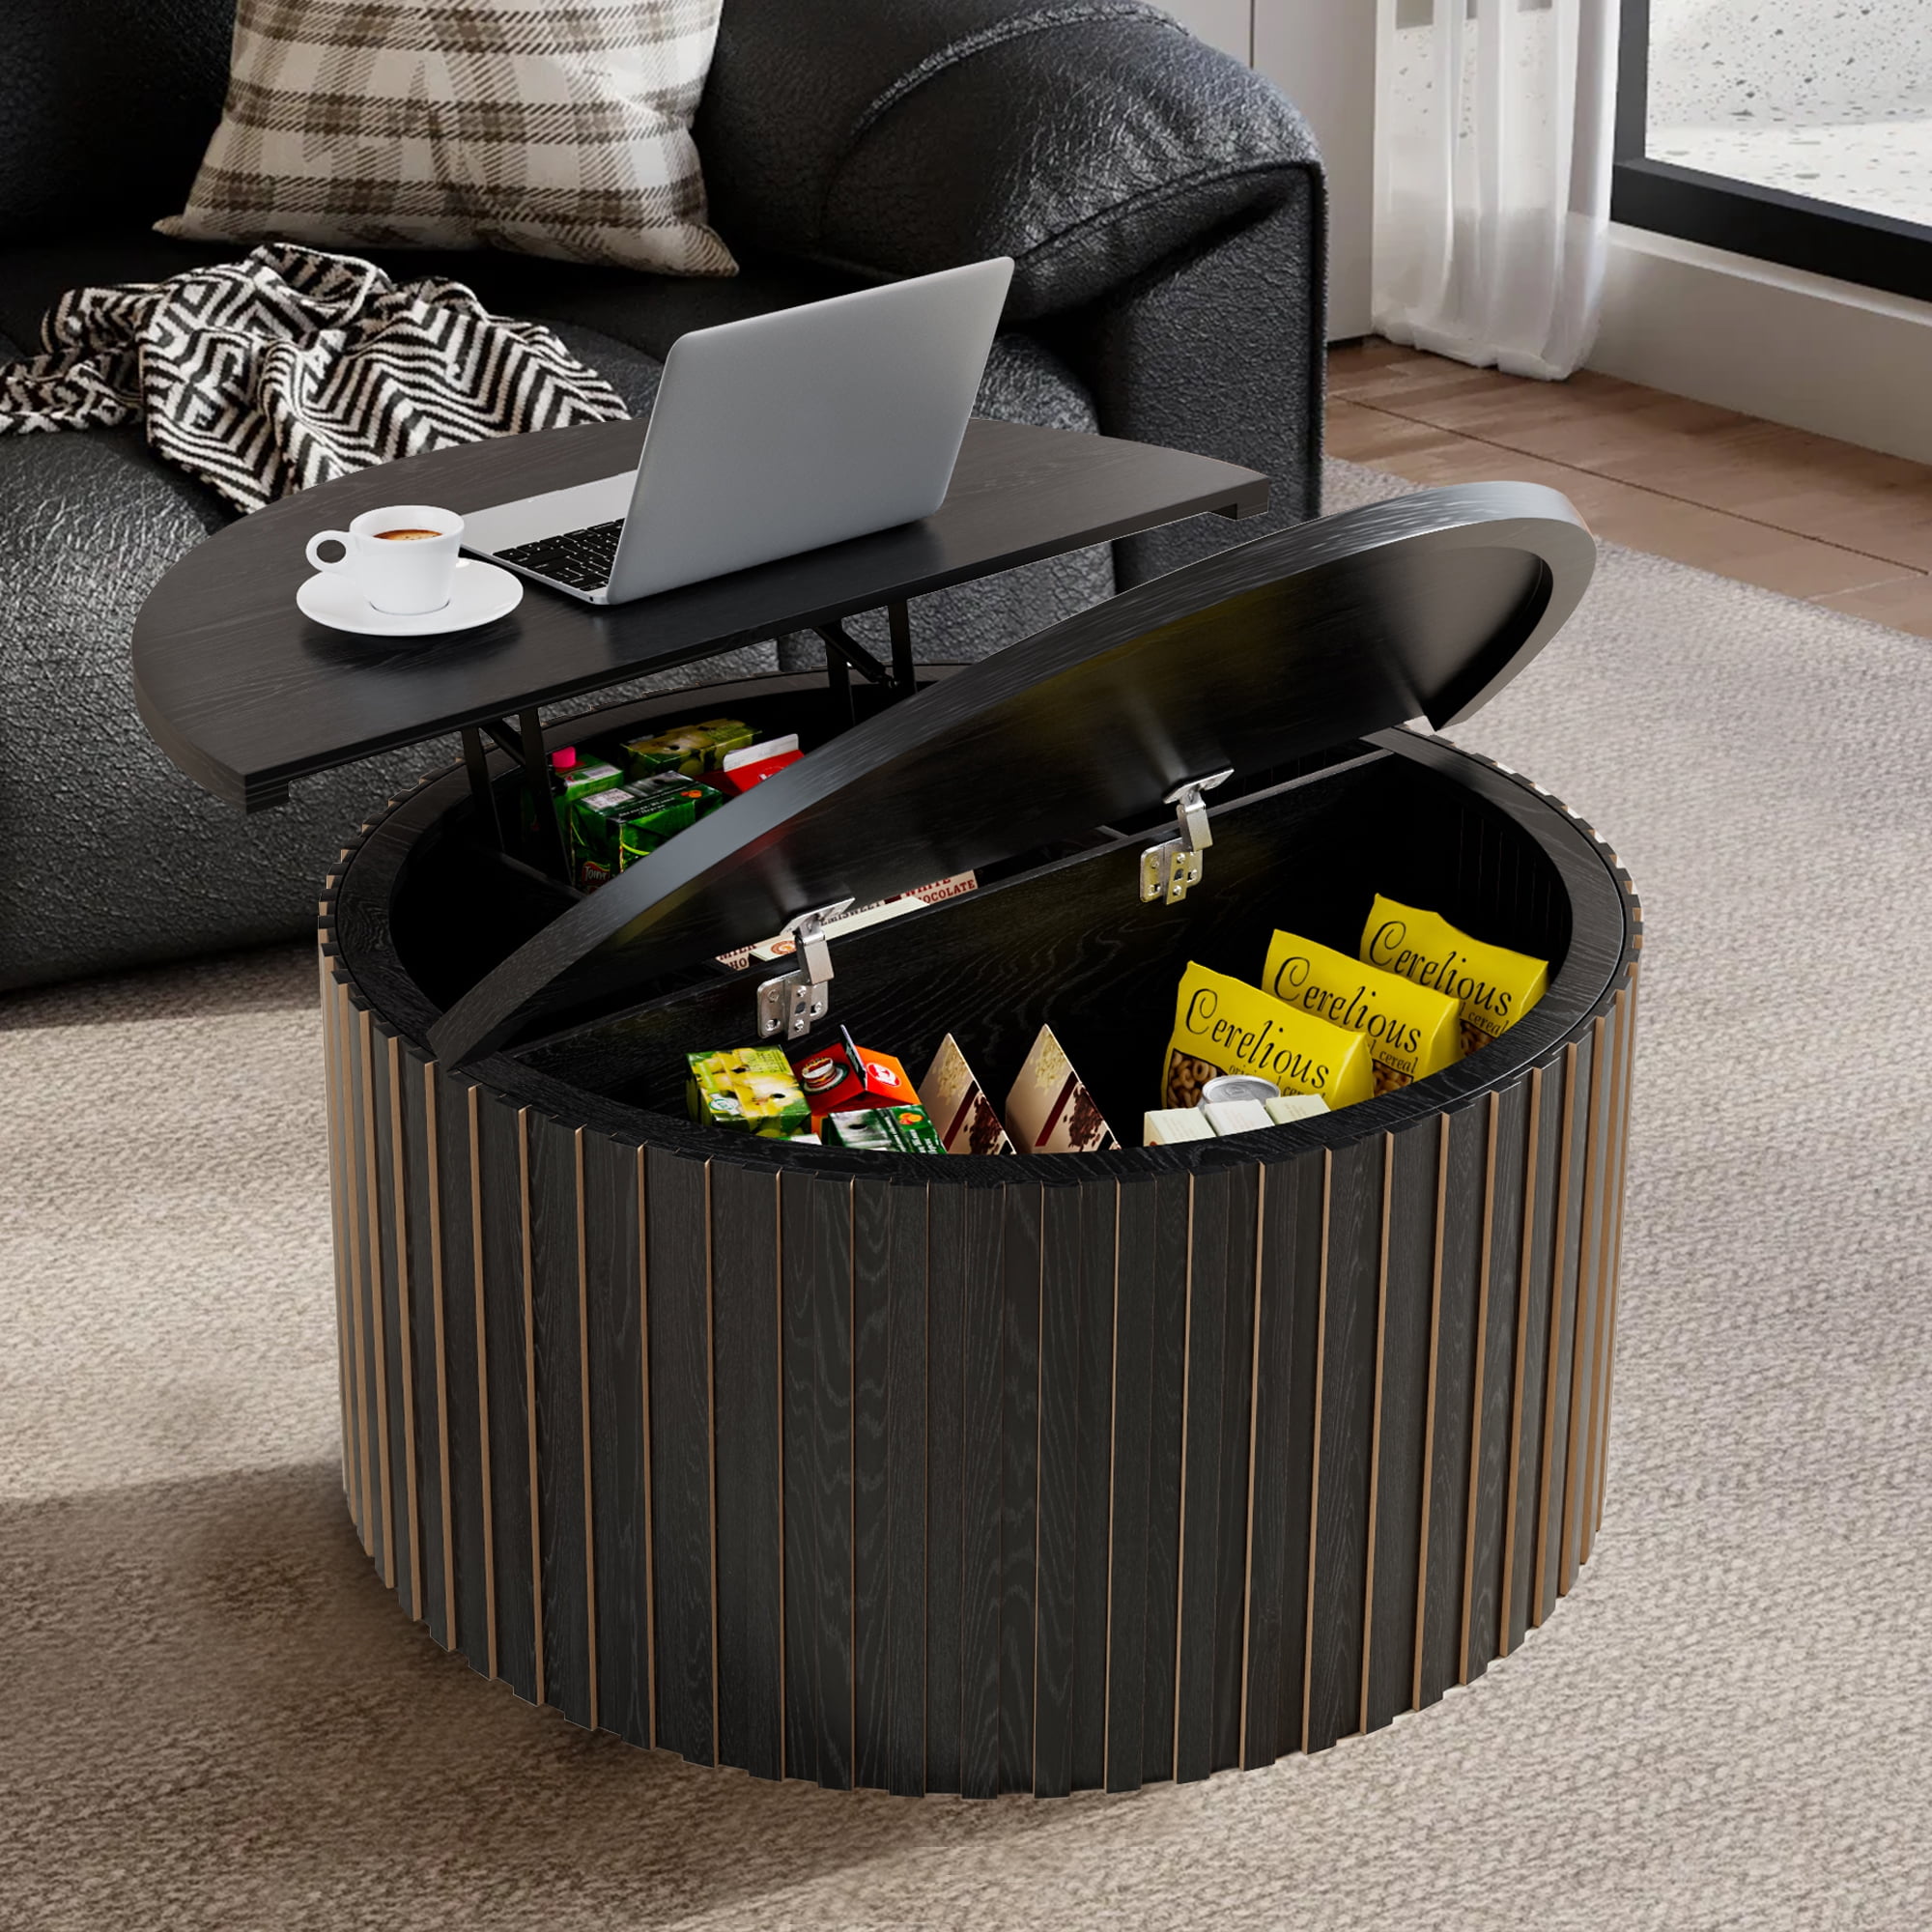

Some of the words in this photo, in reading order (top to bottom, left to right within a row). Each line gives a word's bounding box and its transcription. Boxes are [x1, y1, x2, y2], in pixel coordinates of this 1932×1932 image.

[1273, 956, 1422, 1053] Cerelious
[1369, 921, 1513, 1016] Cerelious
[1184, 987, 1330, 1089] Cerelious
[1379, 1050, 1419, 1074] cereal
